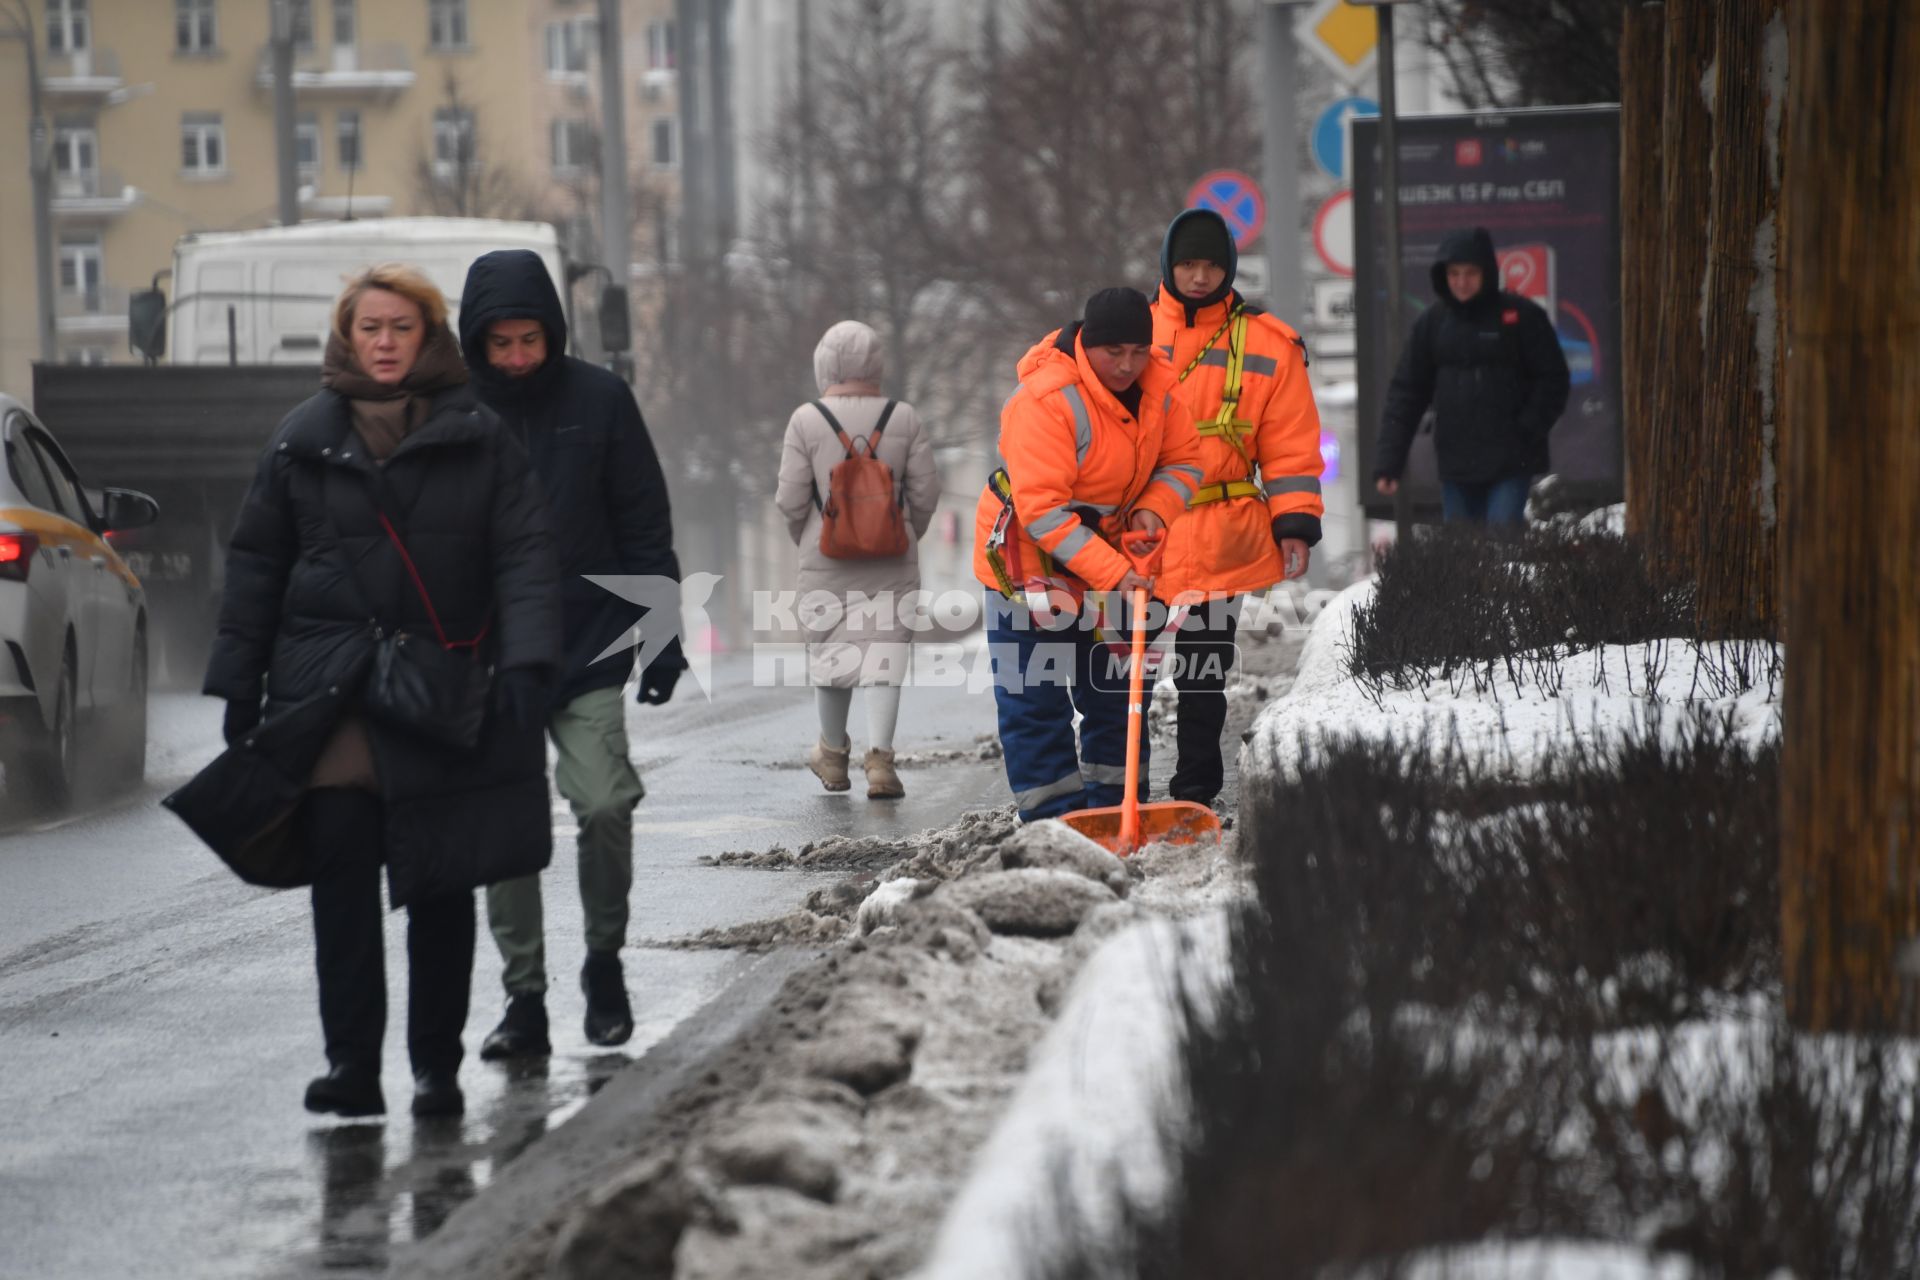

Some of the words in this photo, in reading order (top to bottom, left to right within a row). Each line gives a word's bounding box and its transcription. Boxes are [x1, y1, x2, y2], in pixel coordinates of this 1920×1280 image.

[1459, 183, 1478, 201] 15
[1498, 186, 1519, 200] по
[1524, 180, 1564, 198] СБП
